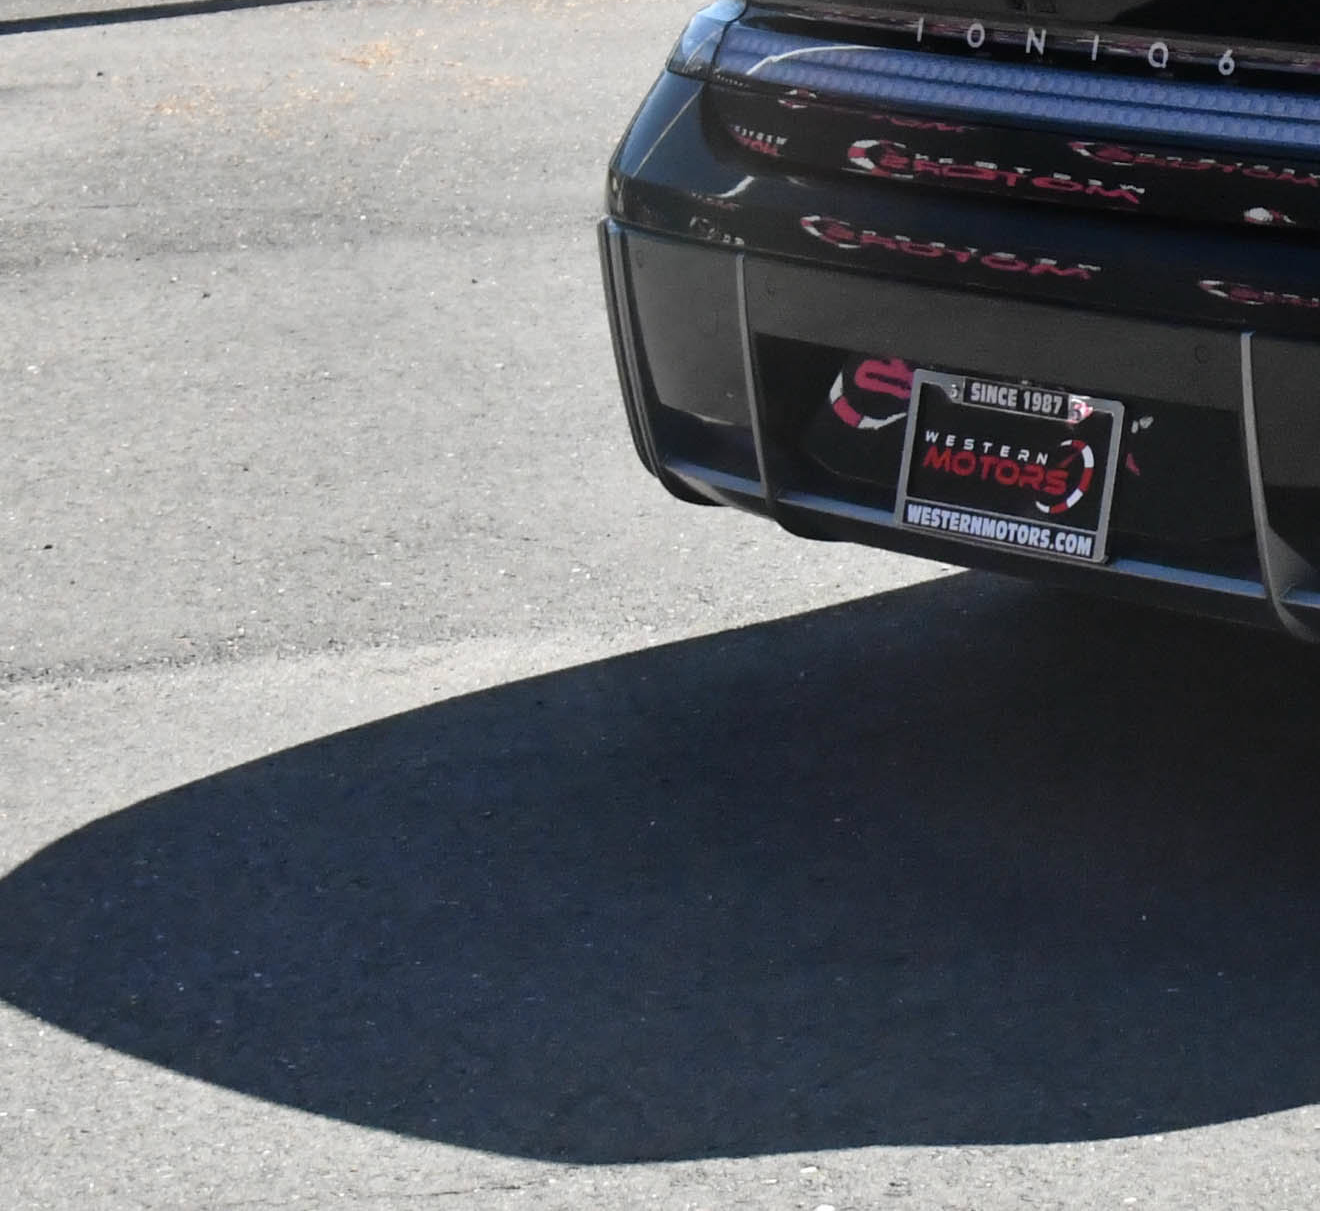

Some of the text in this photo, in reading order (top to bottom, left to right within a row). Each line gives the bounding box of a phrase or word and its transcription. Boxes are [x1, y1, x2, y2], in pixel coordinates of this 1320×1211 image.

[970, 381, 1063, 416] SINCE 1987
[924, 429, 1049, 466] WESTERN
[923, 446, 1070, 496] MOTORS
[906, 503, 1093, 558] WESTERNMOTORS.COM
